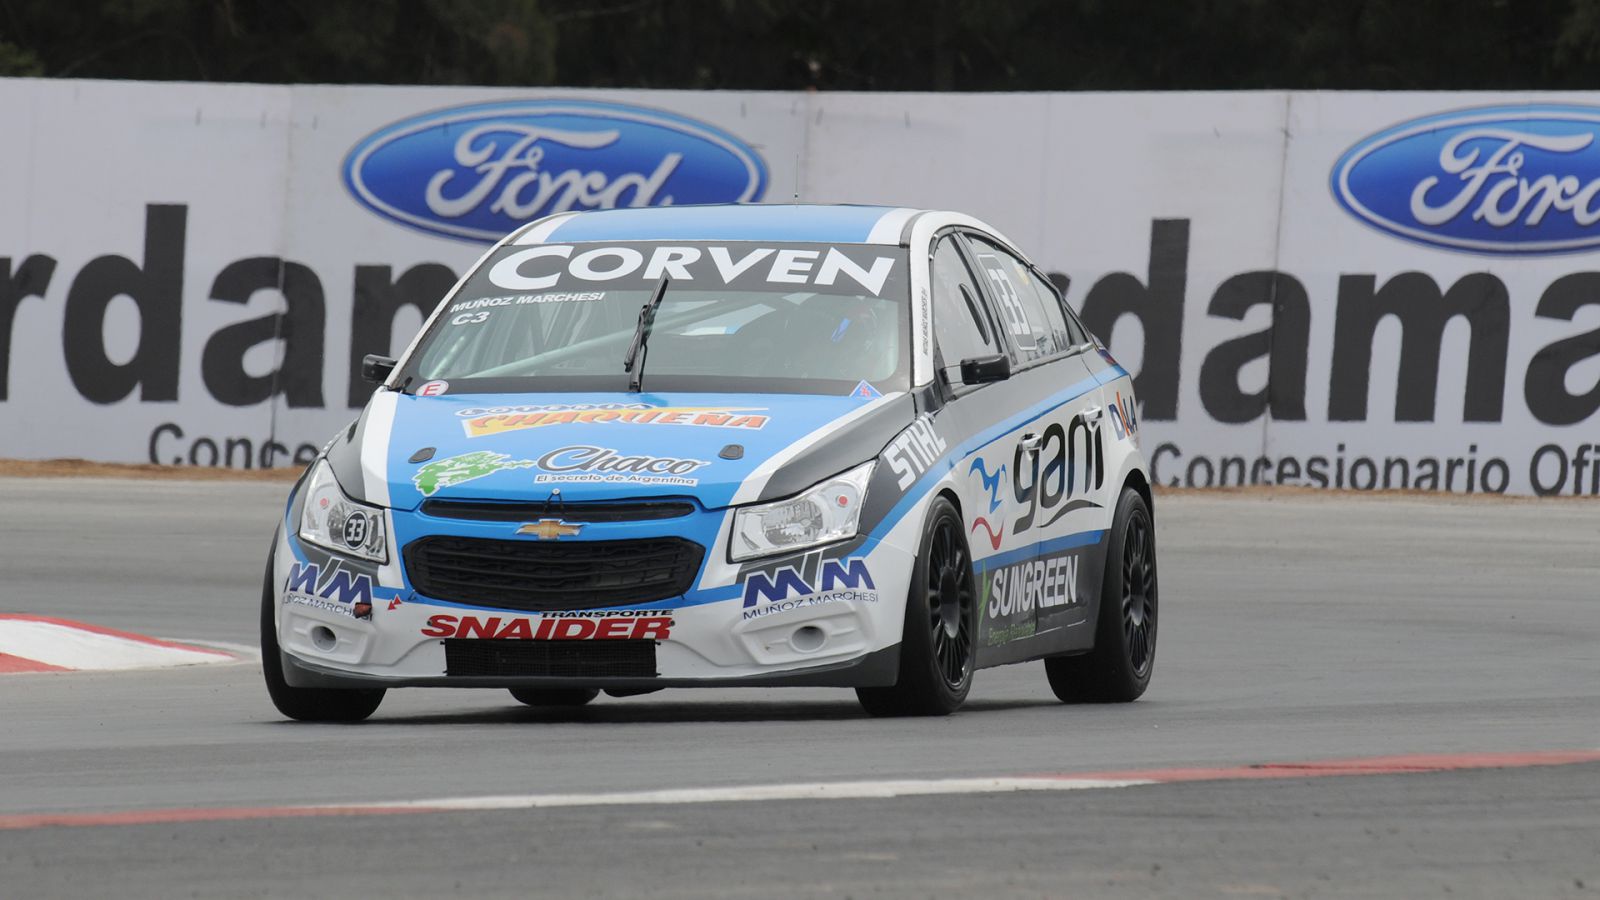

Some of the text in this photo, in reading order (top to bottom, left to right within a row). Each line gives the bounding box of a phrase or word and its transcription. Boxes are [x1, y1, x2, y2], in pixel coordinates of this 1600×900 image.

[426, 122, 683, 219] Ford
[488, 245, 896, 296] CORVEN
[450, 292, 606, 313] MUÑOZ MARCHESI
[987, 268, 1031, 335] 33
[451, 311, 491, 326] C3
[423, 383, 441, 396] E
[469, 408, 765, 430] CHAQUEÑA
[537, 445, 705, 475] Chaco
[884, 415, 947, 492] STIHL
[551, 474, 601, 482] secreto
[606, 474, 625, 482] de
[628, 475, 695, 485] Argentina
[1150, 443, 1510, 494] Concesionario
[346, 519, 365, 542] 33
[989, 555, 1079, 619] SUNGREEN
[540, 609, 674, 619] TRANSPORTE
[742, 590, 879, 620] MUÑOZ MARCHESI
[421, 614, 673, 640] SNAIDER
